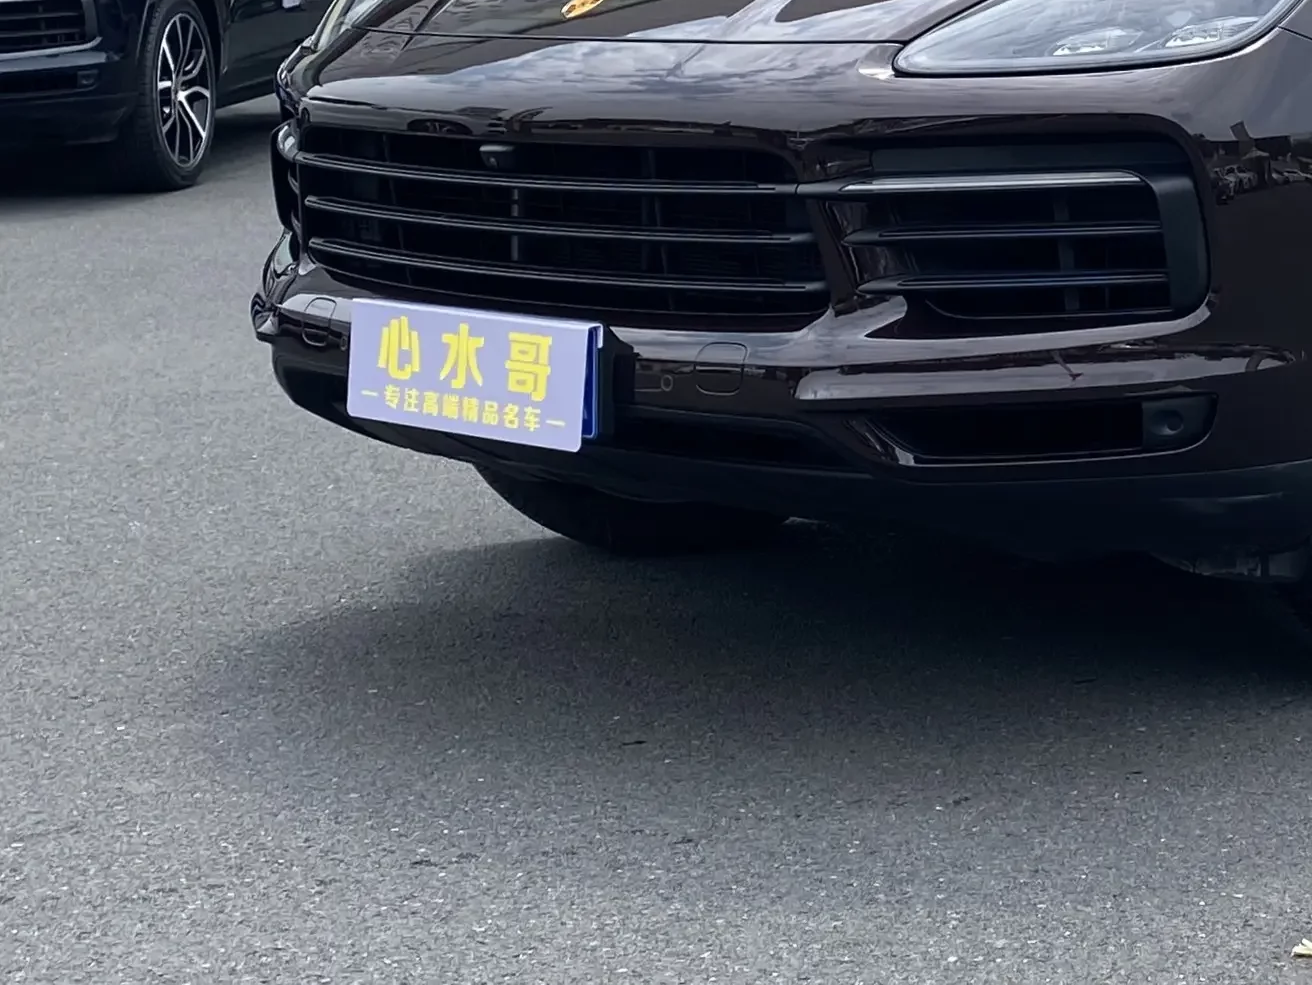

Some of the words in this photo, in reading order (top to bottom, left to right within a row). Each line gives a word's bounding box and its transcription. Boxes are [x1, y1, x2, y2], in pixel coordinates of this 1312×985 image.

[377, 316, 552, 401] 心水哥
[384, 384, 541, 432] 专注高端精品名车
